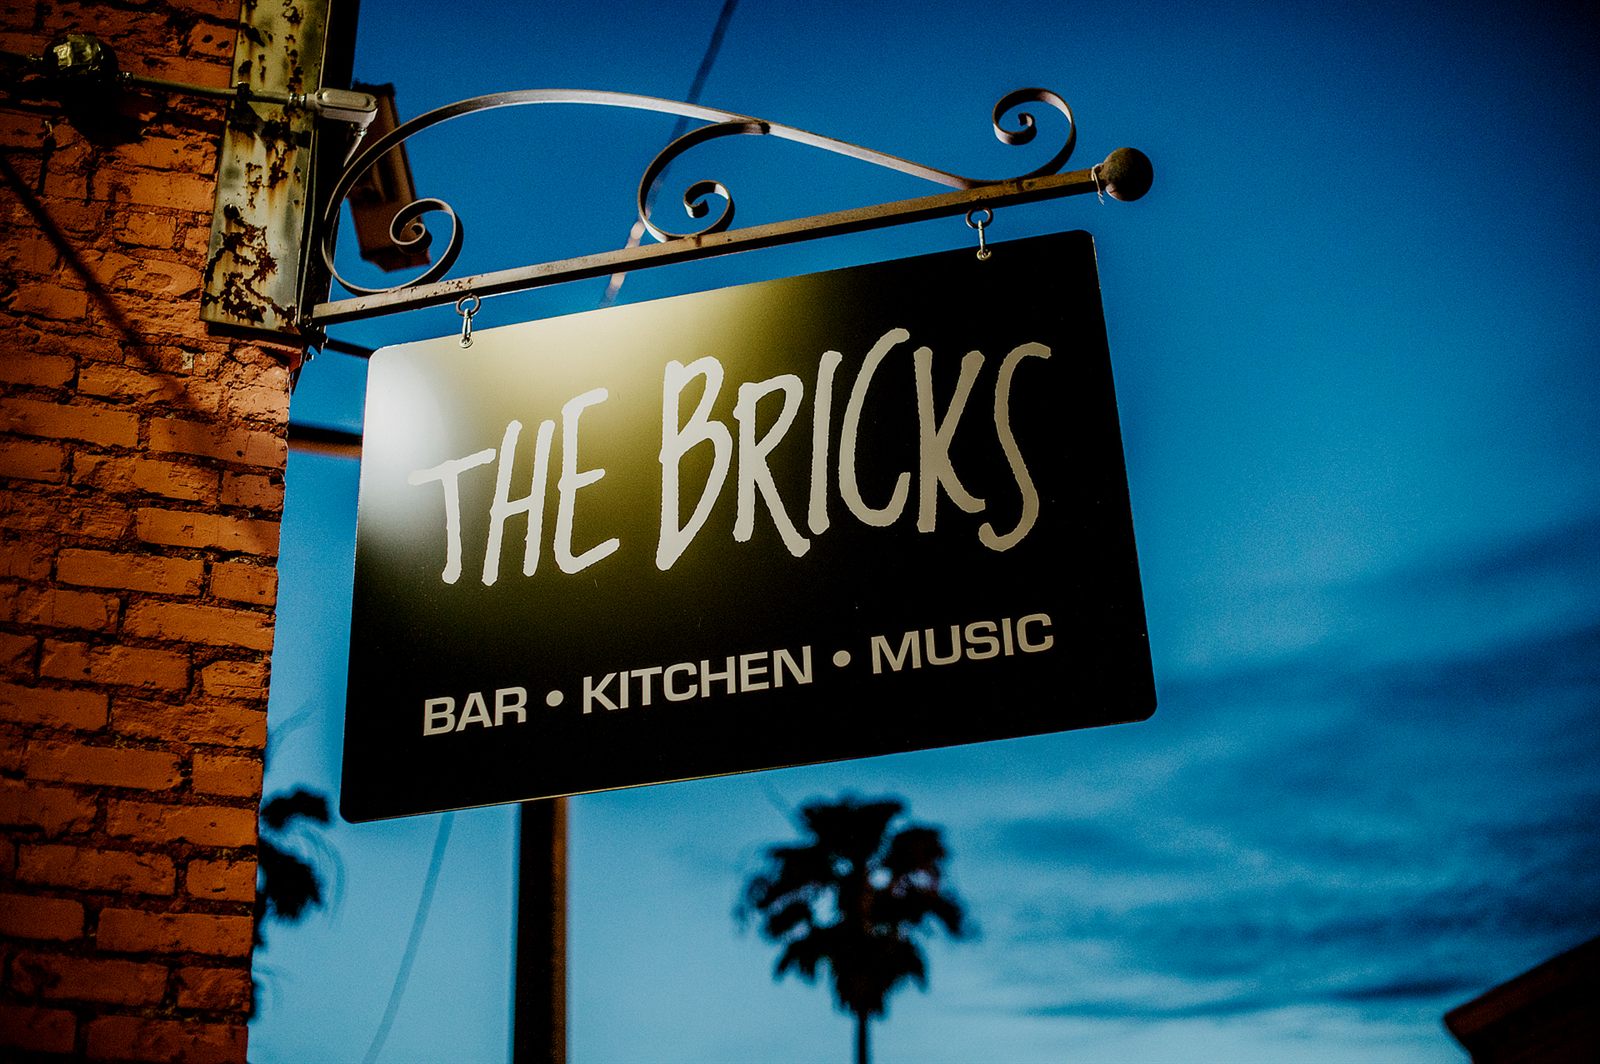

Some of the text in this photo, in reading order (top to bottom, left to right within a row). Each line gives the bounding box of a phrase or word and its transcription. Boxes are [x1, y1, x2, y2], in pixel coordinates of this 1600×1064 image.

[408, 327, 1052, 586] THE BRICKS
[423, 613, 1054, 737] BAR KITCHEN MUSIC
